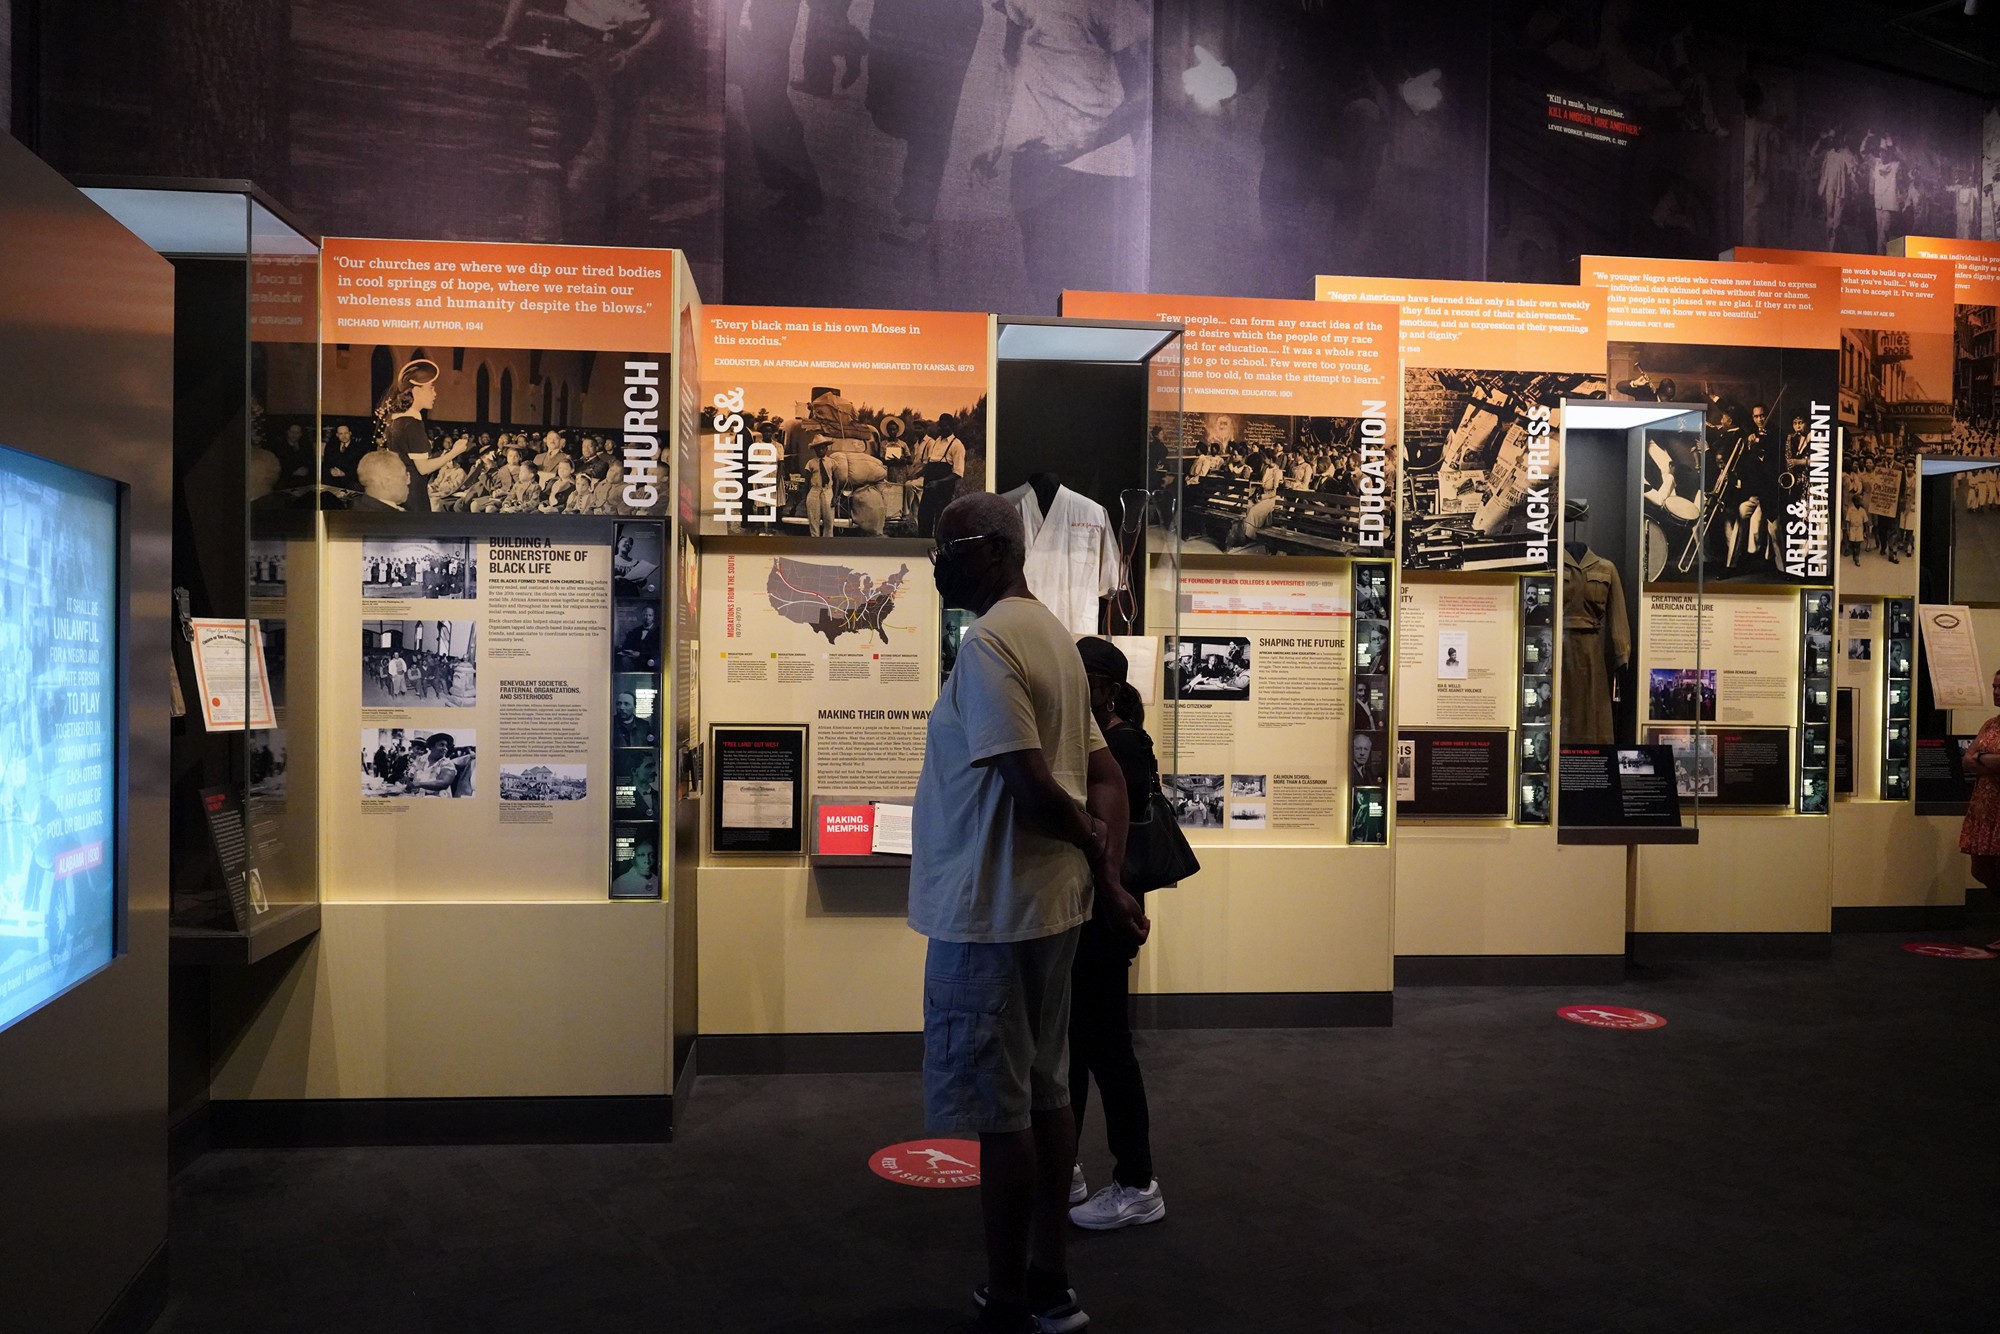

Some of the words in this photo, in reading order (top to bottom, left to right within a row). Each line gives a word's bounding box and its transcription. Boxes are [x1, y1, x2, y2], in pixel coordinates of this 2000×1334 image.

[1568, 100, 1585, 110] mule,
[1586, 103, 1598, 113] buy
[1599, 107, 1625, 118] another.
[333, 255, 365, 268] “Our
[368, 256, 430, 270] churches
[433, 261, 456, 271] are
[459, 260, 502, 273] where
[505, 264, 526, 274] we
[528, 262, 551, 277] dip
[554, 265, 578, 275] our
[581, 264, 614, 277] tired
[618, 265, 661, 278] bodies
[337, 274, 352, 286] in
[354, 275, 383, 287] cool
[386, 276, 436, 292] springs
[440, 277, 454, 289] of
[456, 277, 494, 294] hope,
[497, 279, 540, 292] where
[542, 283, 563, 293] we
[566, 282, 607, 294] retain
[610, 285, 634, 295] our
[1593, 271, 1608, 280] “We
[1609, 273, 1641, 282] younger
[1642, 273, 1665, 284] Negro
[1666, 275, 1691, 283] artists
[1692, 275, 1709, 284] who
[1709, 277, 1733, 285] create
[1734, 278, 1751, 286] now
[1752, 279, 1777, 287] intend
[1787, 281, 1816, 289] express
[1326, 290, 1357, 302] “Negro
[1358, 292, 1406, 302] Americans
[1407, 293, 1428, 303] have
[1430, 294, 1463, 304] learned
[1464, 295, 1482, 305] that
[1484, 297, 1504, 306] only
[1505, 298, 1514, 306] in
[1516, 298, 1537, 307] their
[1538, 300, 1558, 308] own
[1558, 300, 1590, 310] weekly
[1844, 286, 1861, 294] have
[1870, 288, 1892, 297] accept
[1900, 289, 1914, 297] I've
[336, 292, 411, 307] wholeness
[415, 295, 441, 307] and
[446, 295, 515, 312] humanity
[519, 298, 570, 313] despite
[574, 300, 597, 312] the
[601, 300, 652, 314] blows.”
[337, 317, 380, 327] RICHARD
[381, 318, 421, 329] WRIGHT,
[422, 320, 464, 330] AUTHOR,
[465, 321, 483, 330] 1941
[710, 318, 748, 332] “Every
[750, 319, 782, 330] black
[784, 322, 809, 331] man
[812, 323, 822, 331] is
[824, 321, 842, 332] his
[843, 324, 868, 333] own
[870, 322, 906, 334] Moses
[908, 323, 920, 334] in
[1155, 312, 1181, 323] “Few
[1184, 314, 1227, 326] people...
[1229, 317, 1247, 325] can
[1250, 316, 1275, 326] form
[1277, 319, 1296, 329] any
[1298, 319, 1326, 328] exact
[1328, 319, 1350, 329] idea
[1352, 320, 1363, 330] of
[1365, 320, 1382, 331] the
[713, 333, 736, 345] this
[737, 334, 787, 346] exodus.”
[713, 357, 762, 367] EXODUSTER,
[762, 358, 774, 366] AN
[775, 358, 809, 367] AFRICAN
[809, 360, 850, 368] AMERICAN
[850, 361, 870, 369] WHO
[870, 361, 911, 370] MIGRATED
[912, 362, 922, 370] TO
[923, 362, 956, 372] KANSAS,
[957, 363, 974, 372] 1879
[1193, 387, 1240, 396] WASHINGTON,
[1241, 388, 1279, 398] EDUCATOR,
[622, 361, 659, 508] CHURCH
[1527, 405, 1550, 480] PRESS
[747, 442, 777, 522] LAND
[1359, 400, 1387, 547] EDUCATION
[1808, 401, 1831, 577] ENTERTAINMENT
[1786, 499, 1807, 518] &
[1526, 487, 1549, 562] BLACK
[489, 536, 542, 548] BUILDING
[543, 537, 552, 548] A
[1786, 521, 1807, 577] ARTS
[489, 549, 571, 561] CORNERSTONE
[574, 550, 588, 562] OF
[489, 562, 525, 573] BLACK
[528, 562, 551, 574] LIFE
[66, 597, 72, 613] IT
[73, 598, 91, 615] SHALL
[92, 601, 99, 616] BE
[1650, 602, 1684, 611] AMERICAN
[1651, 594, 1683, 602] CREATING
[53, 616, 99, 643] UNLAWFUL
[727, 604, 735, 638] MIGRATIONS
[1259, 638, 1295, 647] SHAPING
[1296, 638, 1312, 647] THE
[1314, 639, 1345, 648] FUTURE
[67, 692, 78, 715] TO
[80, 691, 100, 714] PLAY
[818, 709, 855, 719] MAKING
[858, 710, 885, 719] THEIR
[887, 710, 909, 720] OWN
[911, 710, 931, 720] WAY
[825, 814, 863, 824] MAKING
[826, 824, 869, 832] MEMPHIS
[59, 850, 84, 874] ALABAMA
[87, 847, 100, 864] 1930
[900, 1172, 934, 1183] SAFE
